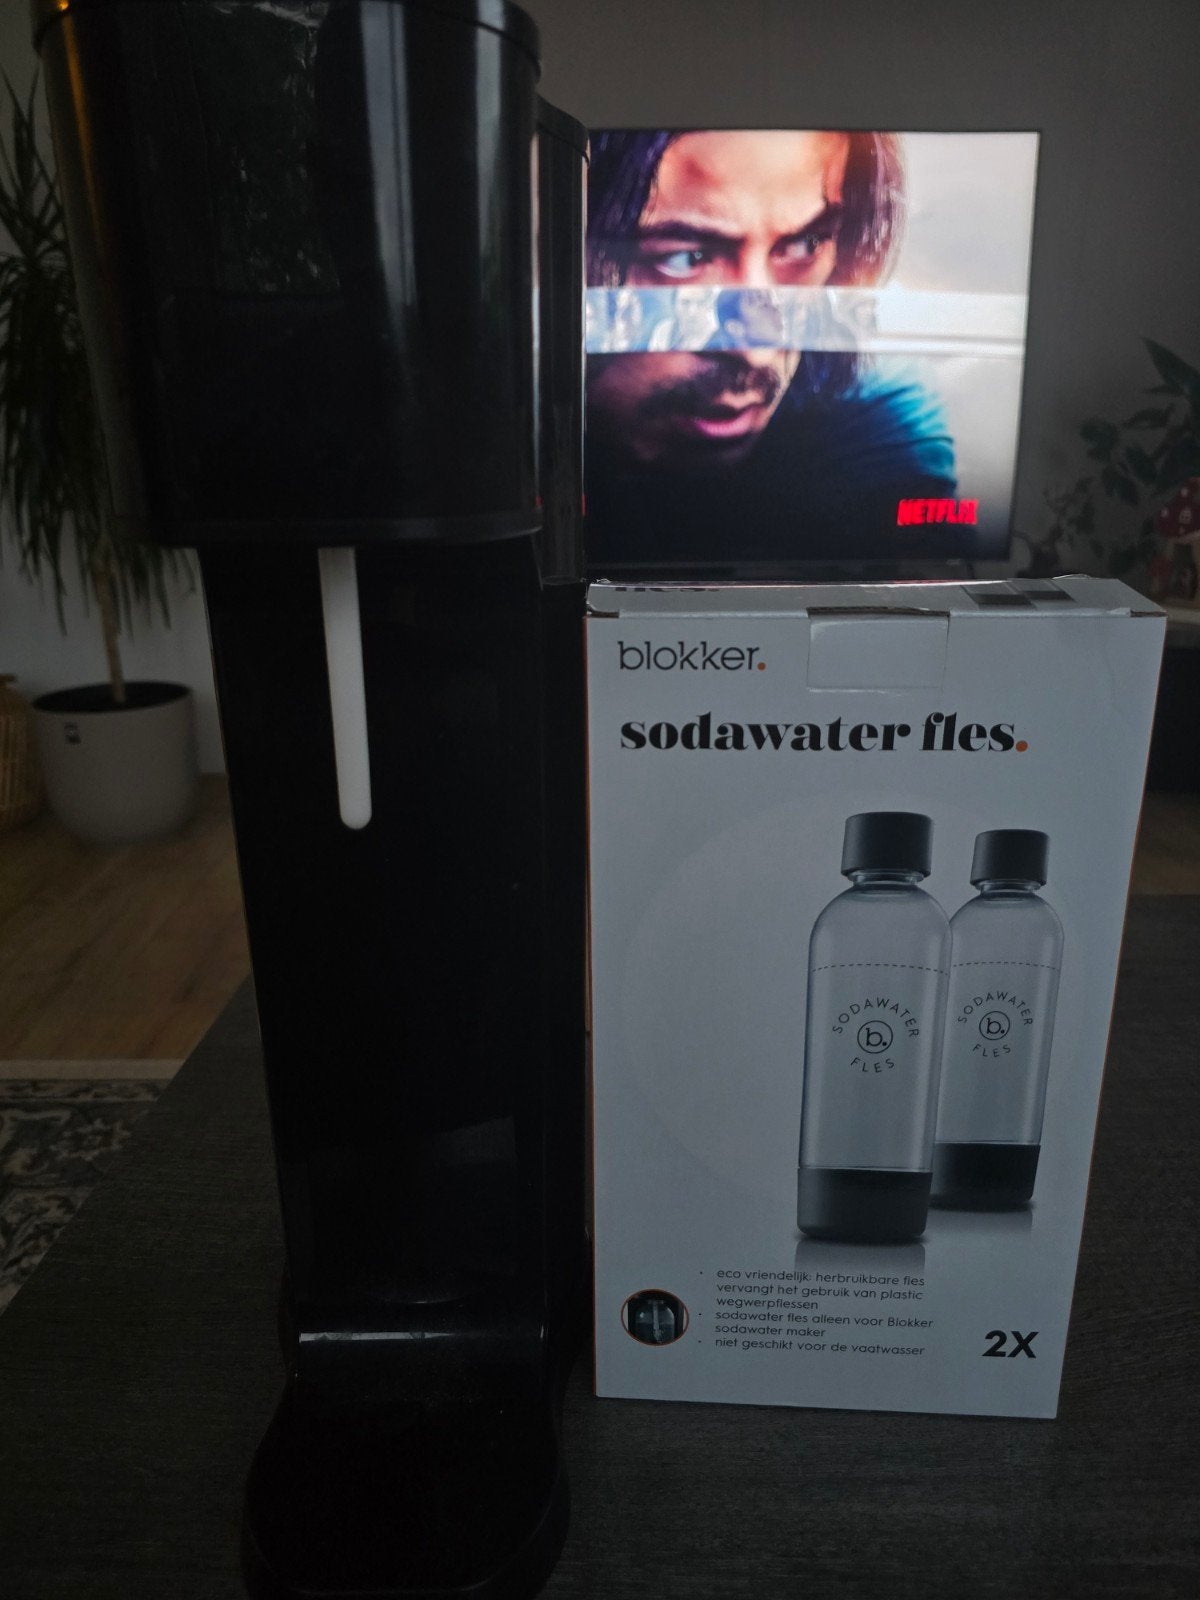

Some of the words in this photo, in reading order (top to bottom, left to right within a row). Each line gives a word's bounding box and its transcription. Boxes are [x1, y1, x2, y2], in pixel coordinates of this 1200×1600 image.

[617, 640, 767, 672] blokker.
[620, 711, 911, 752] sodawater
[919, 711, 1029, 753] fles.
[957, 990, 1033, 1026] SODAWATER
[832, 997, 920, 1038] SODAWATER
[972, 1043, 1012, 1058] FLES
[850, 1057, 895, 1074] FLES
[717, 1270, 741, 1279] eco
[745, 1270, 811, 1283] vriendelijk:
[816, 1272, 899, 1285] herbruikbare
[903, 1275, 925, 1286] fles
[717, 1284, 774, 1296] vervangt
[778, 1285, 799, 1294] het
[802, 1286, 850, 1298] gebruik
[853, 1290, 876, 1298] van
[880, 1290, 923, 1300] plastic
[717, 1298, 818, 1310] wegwerpflessen
[715, 1311, 783, 1322] sodawater
[787, 1313, 808, 1323] fles
[812, 1314, 850, 1325] alleen
[854, 1317, 884, 1326] voor
[888, 1317, 934, 1327] Blokker
[715, 1324, 782, 1335] sodawater
[786, 1327, 826, 1337] maker
[715, 1337, 738, 1347] niet
[742, 1340, 793, 1350] geschikt
[797, 1343, 827, 1351] voor
[830, 1342, 848, 1352] de
[851, 1344, 925, 1355] vaatwasser
[981, 1329, 1039, 1359] 2X
